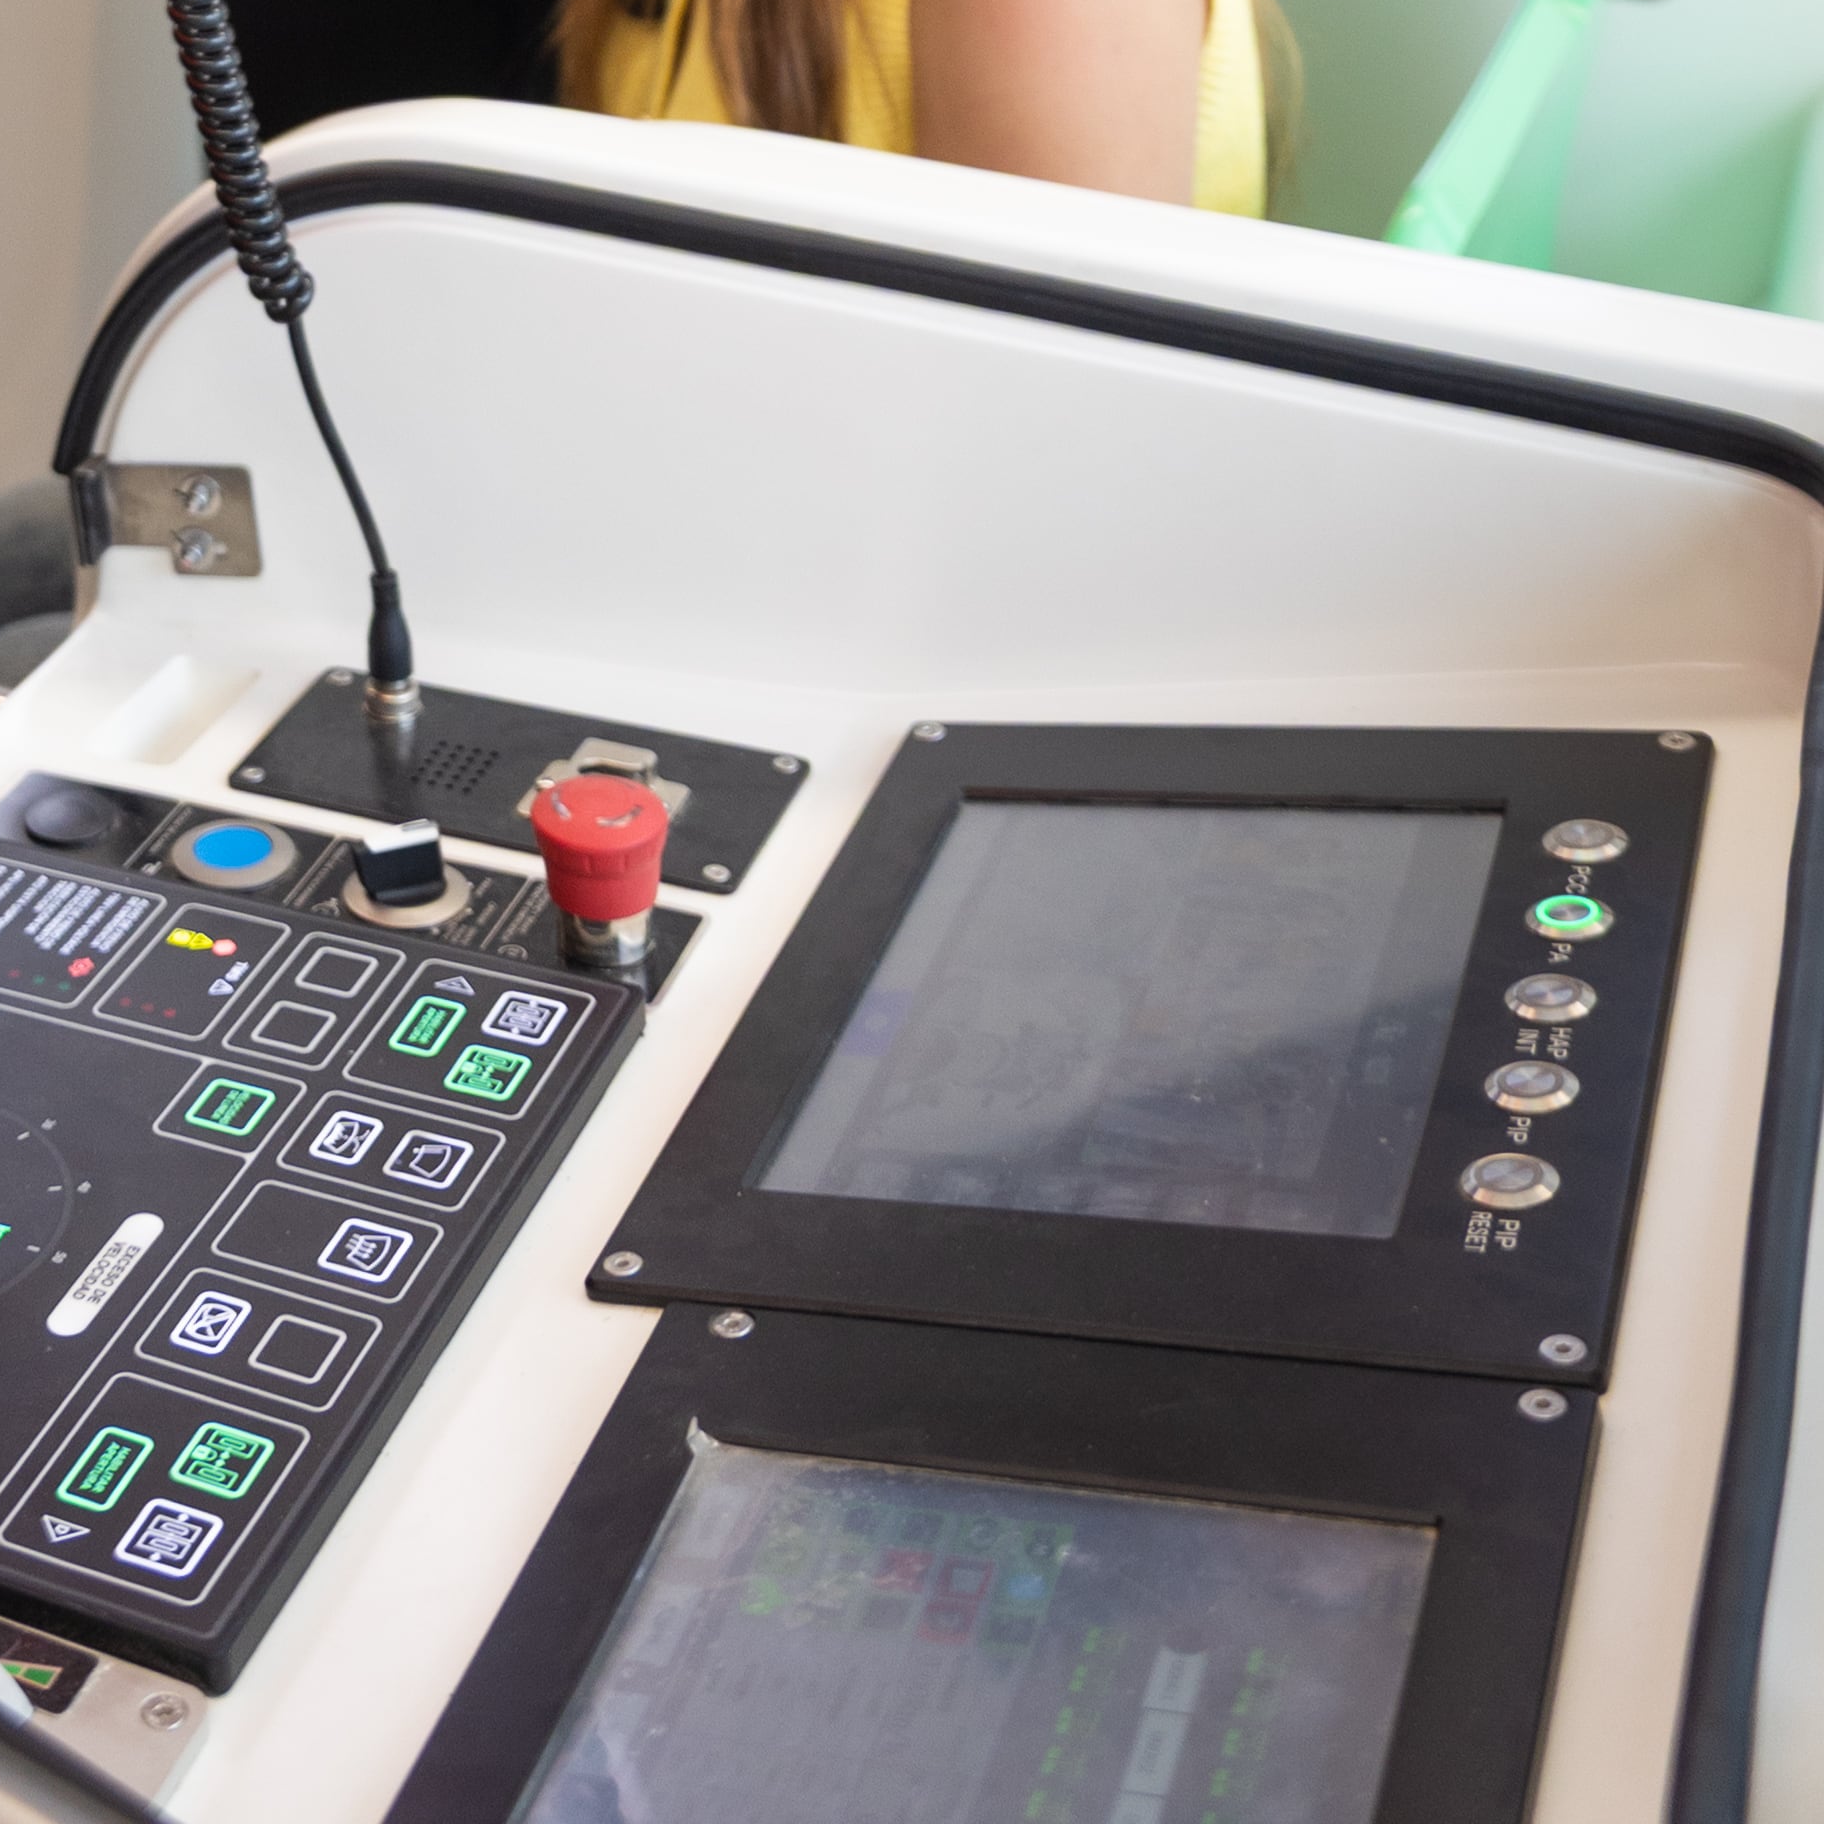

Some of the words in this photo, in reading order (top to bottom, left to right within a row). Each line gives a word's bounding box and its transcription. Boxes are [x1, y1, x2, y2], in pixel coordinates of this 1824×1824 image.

[1564, 865, 1592, 894] PCC
[1548, 942, 1573, 964] PA
[1514, 1028, 1539, 1055] INT
[1547, 1027, 1572, 1059] HAP
[1507, 1116, 1531, 1144] PIP
[1464, 1210, 1492, 1253] RESET
[1494, 1219, 1520, 1249] PIP
[72, 1242, 126, 1300] VELOCIDAD
[101, 1245, 140, 1287] EXCESO
[87, 1289, 106, 1304] DE
[77, 1441, 120, 1490] APERTURA
[91, 1446, 132, 1493] HABILITAR
